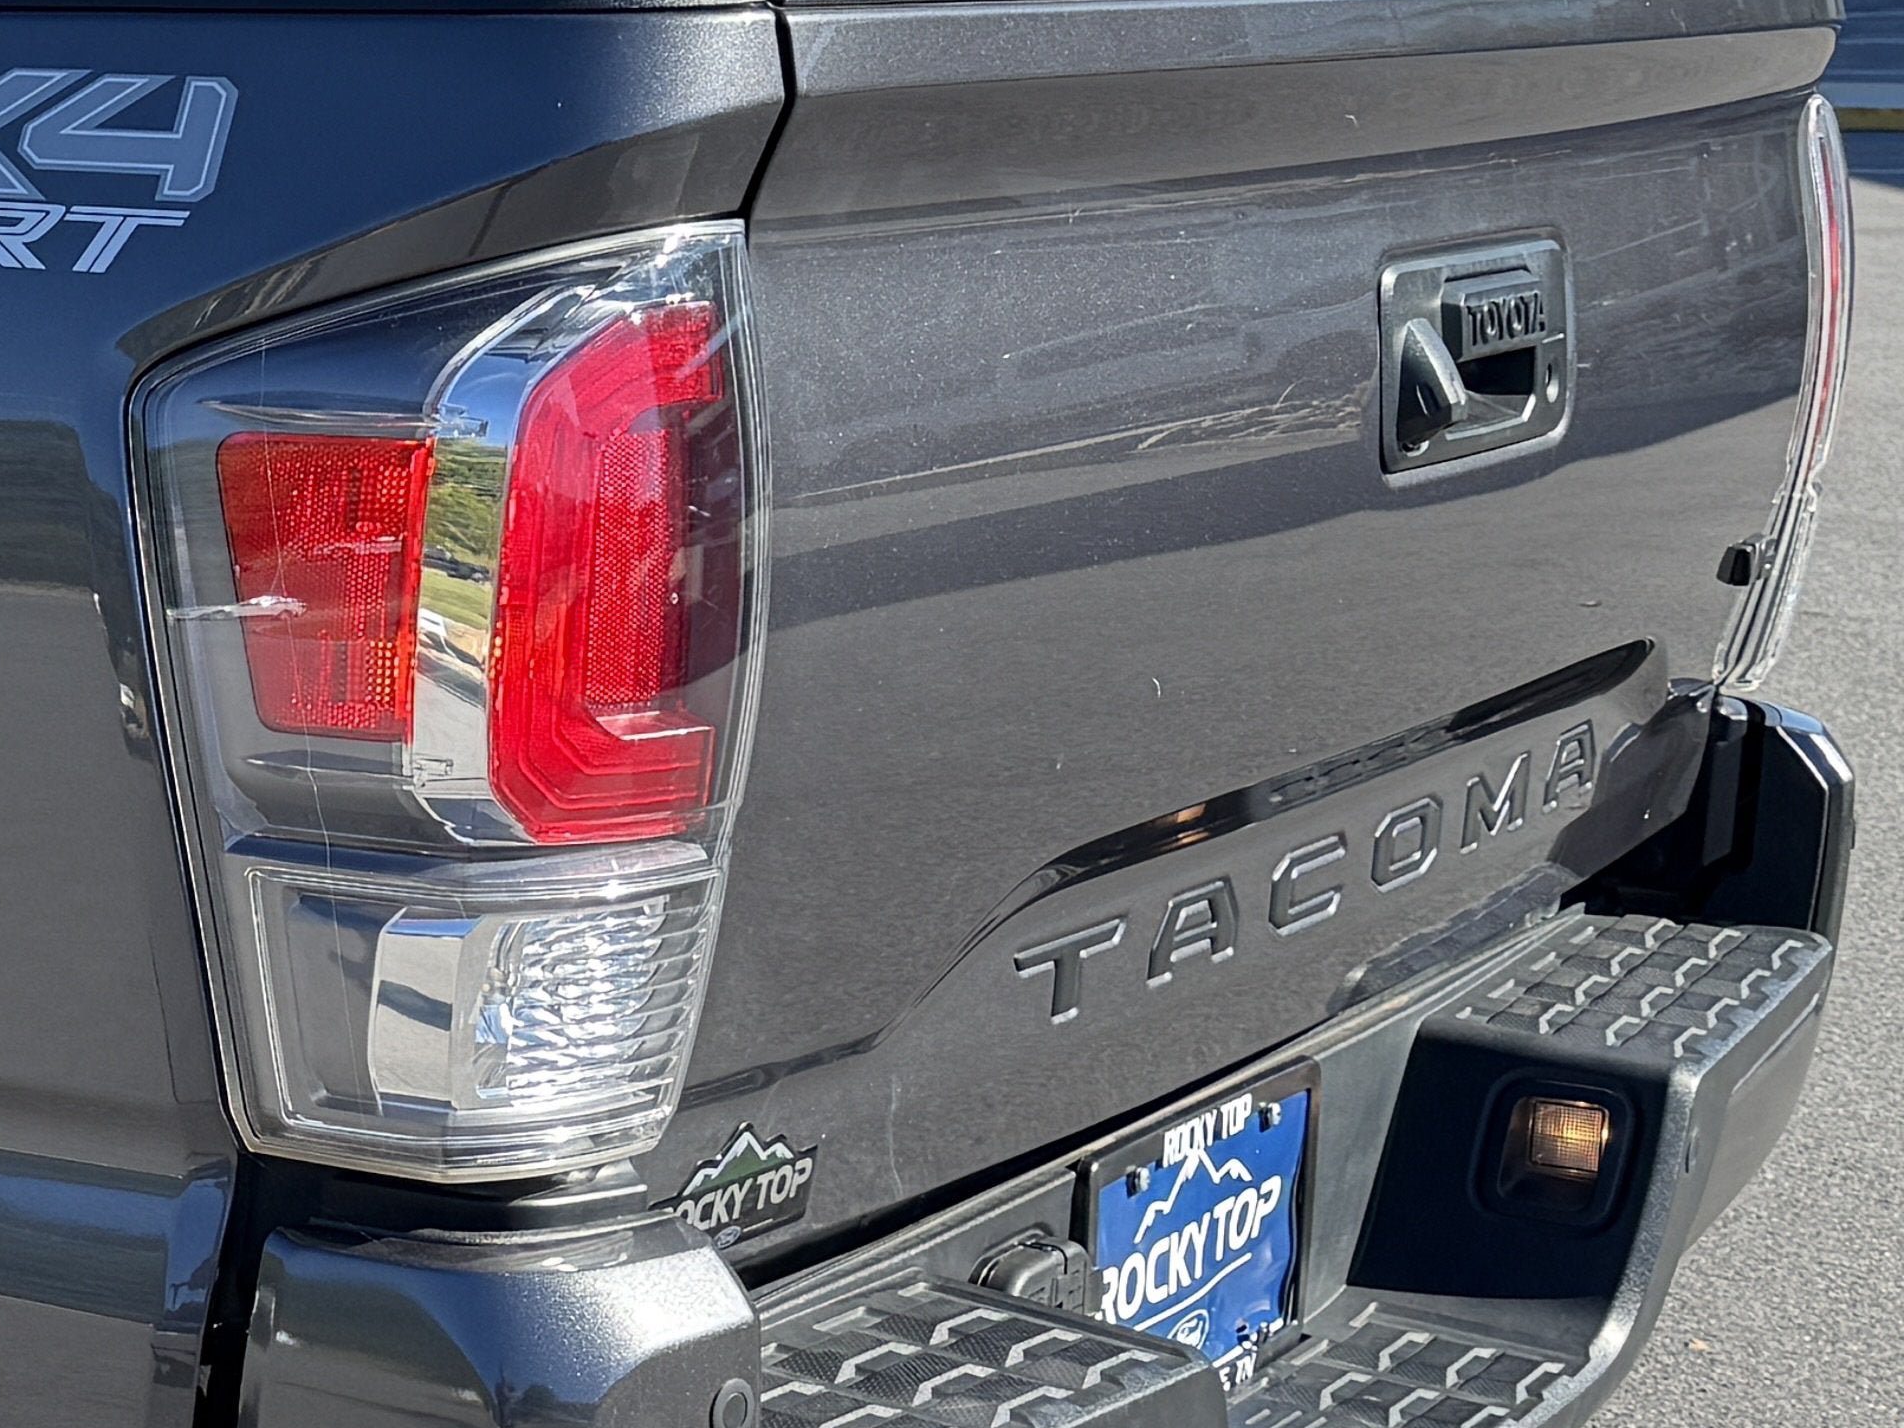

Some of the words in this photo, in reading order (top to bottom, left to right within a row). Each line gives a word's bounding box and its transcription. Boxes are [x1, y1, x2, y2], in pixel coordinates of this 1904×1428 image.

[1467, 290, 1546, 347] TOYOTA
[1012, 718, 1598, 1024] TACOMA
[1162, 1109, 1218, 1169] ROCKY
[1220, 1092, 1253, 1140] TOP
[662, 1177, 754, 1231] OCKY
[756, 1157, 814, 1210] TOP
[1095, 1212, 1212, 1325] ROCKY
[1213, 1175, 1282, 1261] TOP
